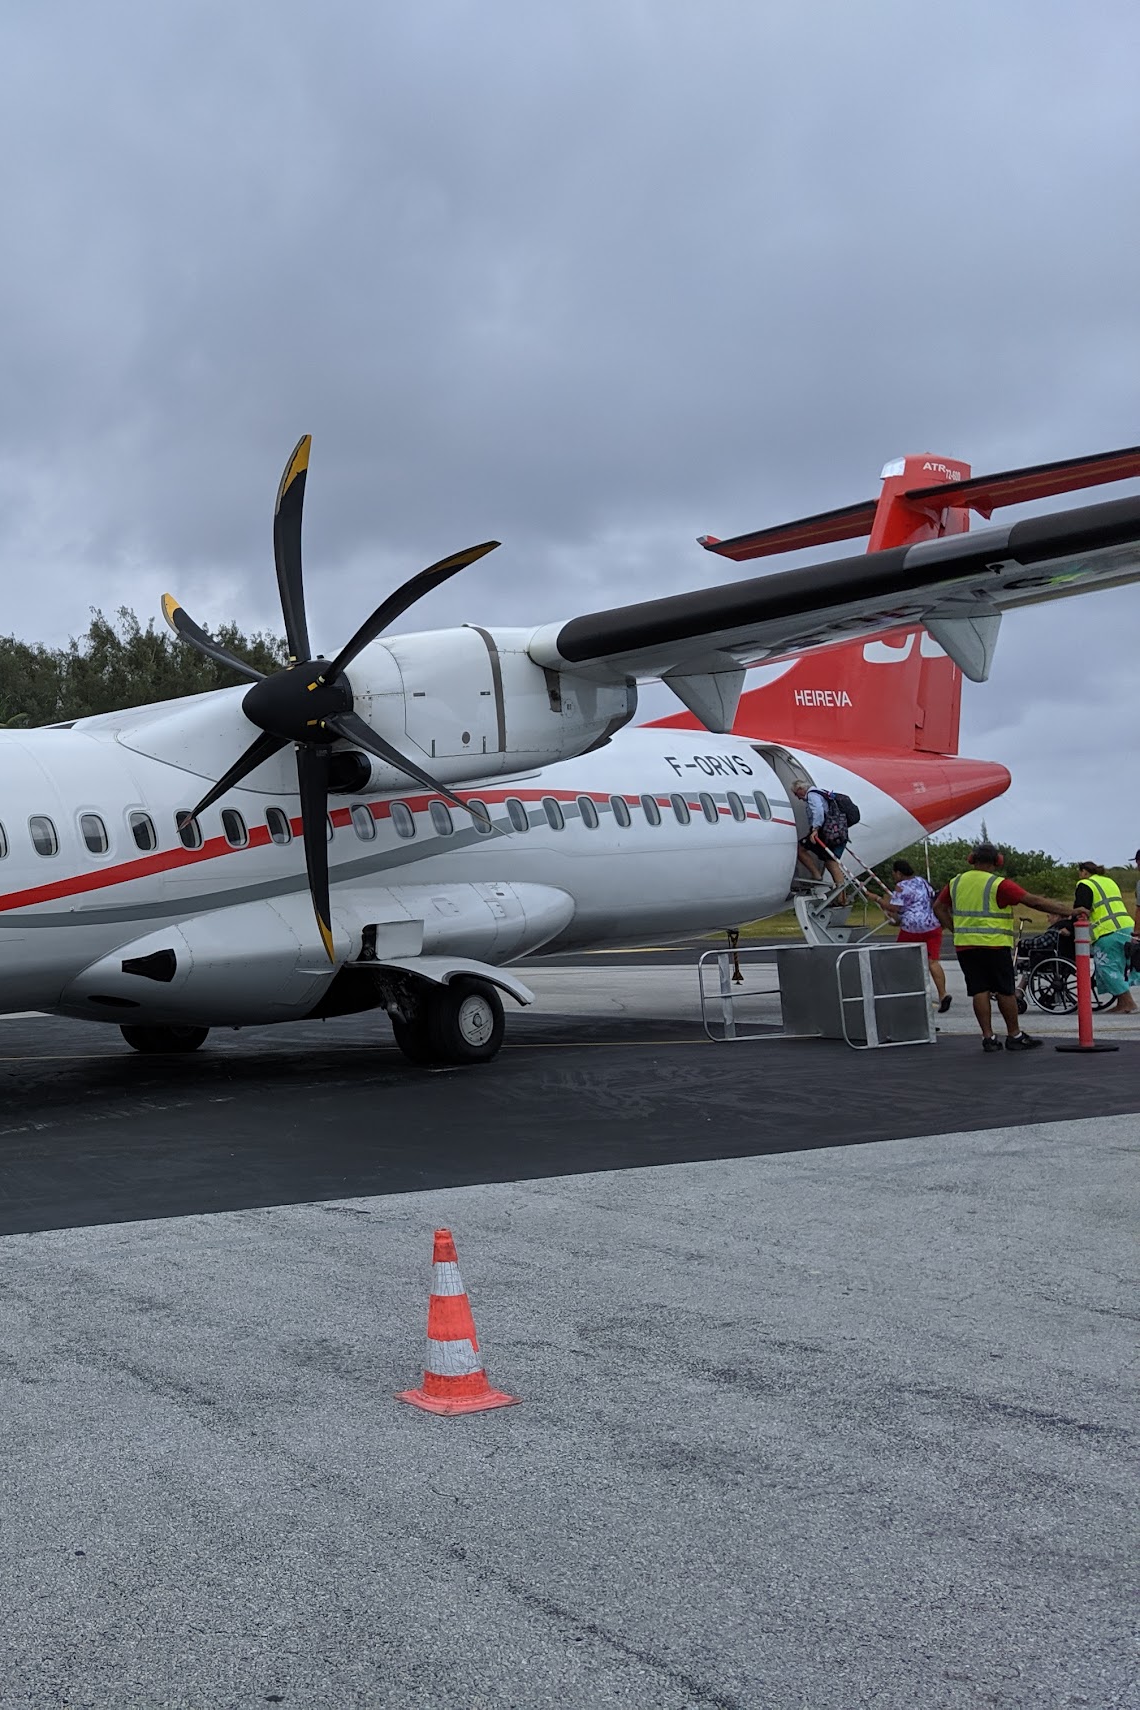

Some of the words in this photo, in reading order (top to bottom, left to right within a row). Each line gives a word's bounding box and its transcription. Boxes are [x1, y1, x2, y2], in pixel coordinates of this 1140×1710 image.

[923, 462, 946, 473] ATR
[794, 690, 853, 707] HEIREVA
[664, 755, 754, 778] F-ORVS
